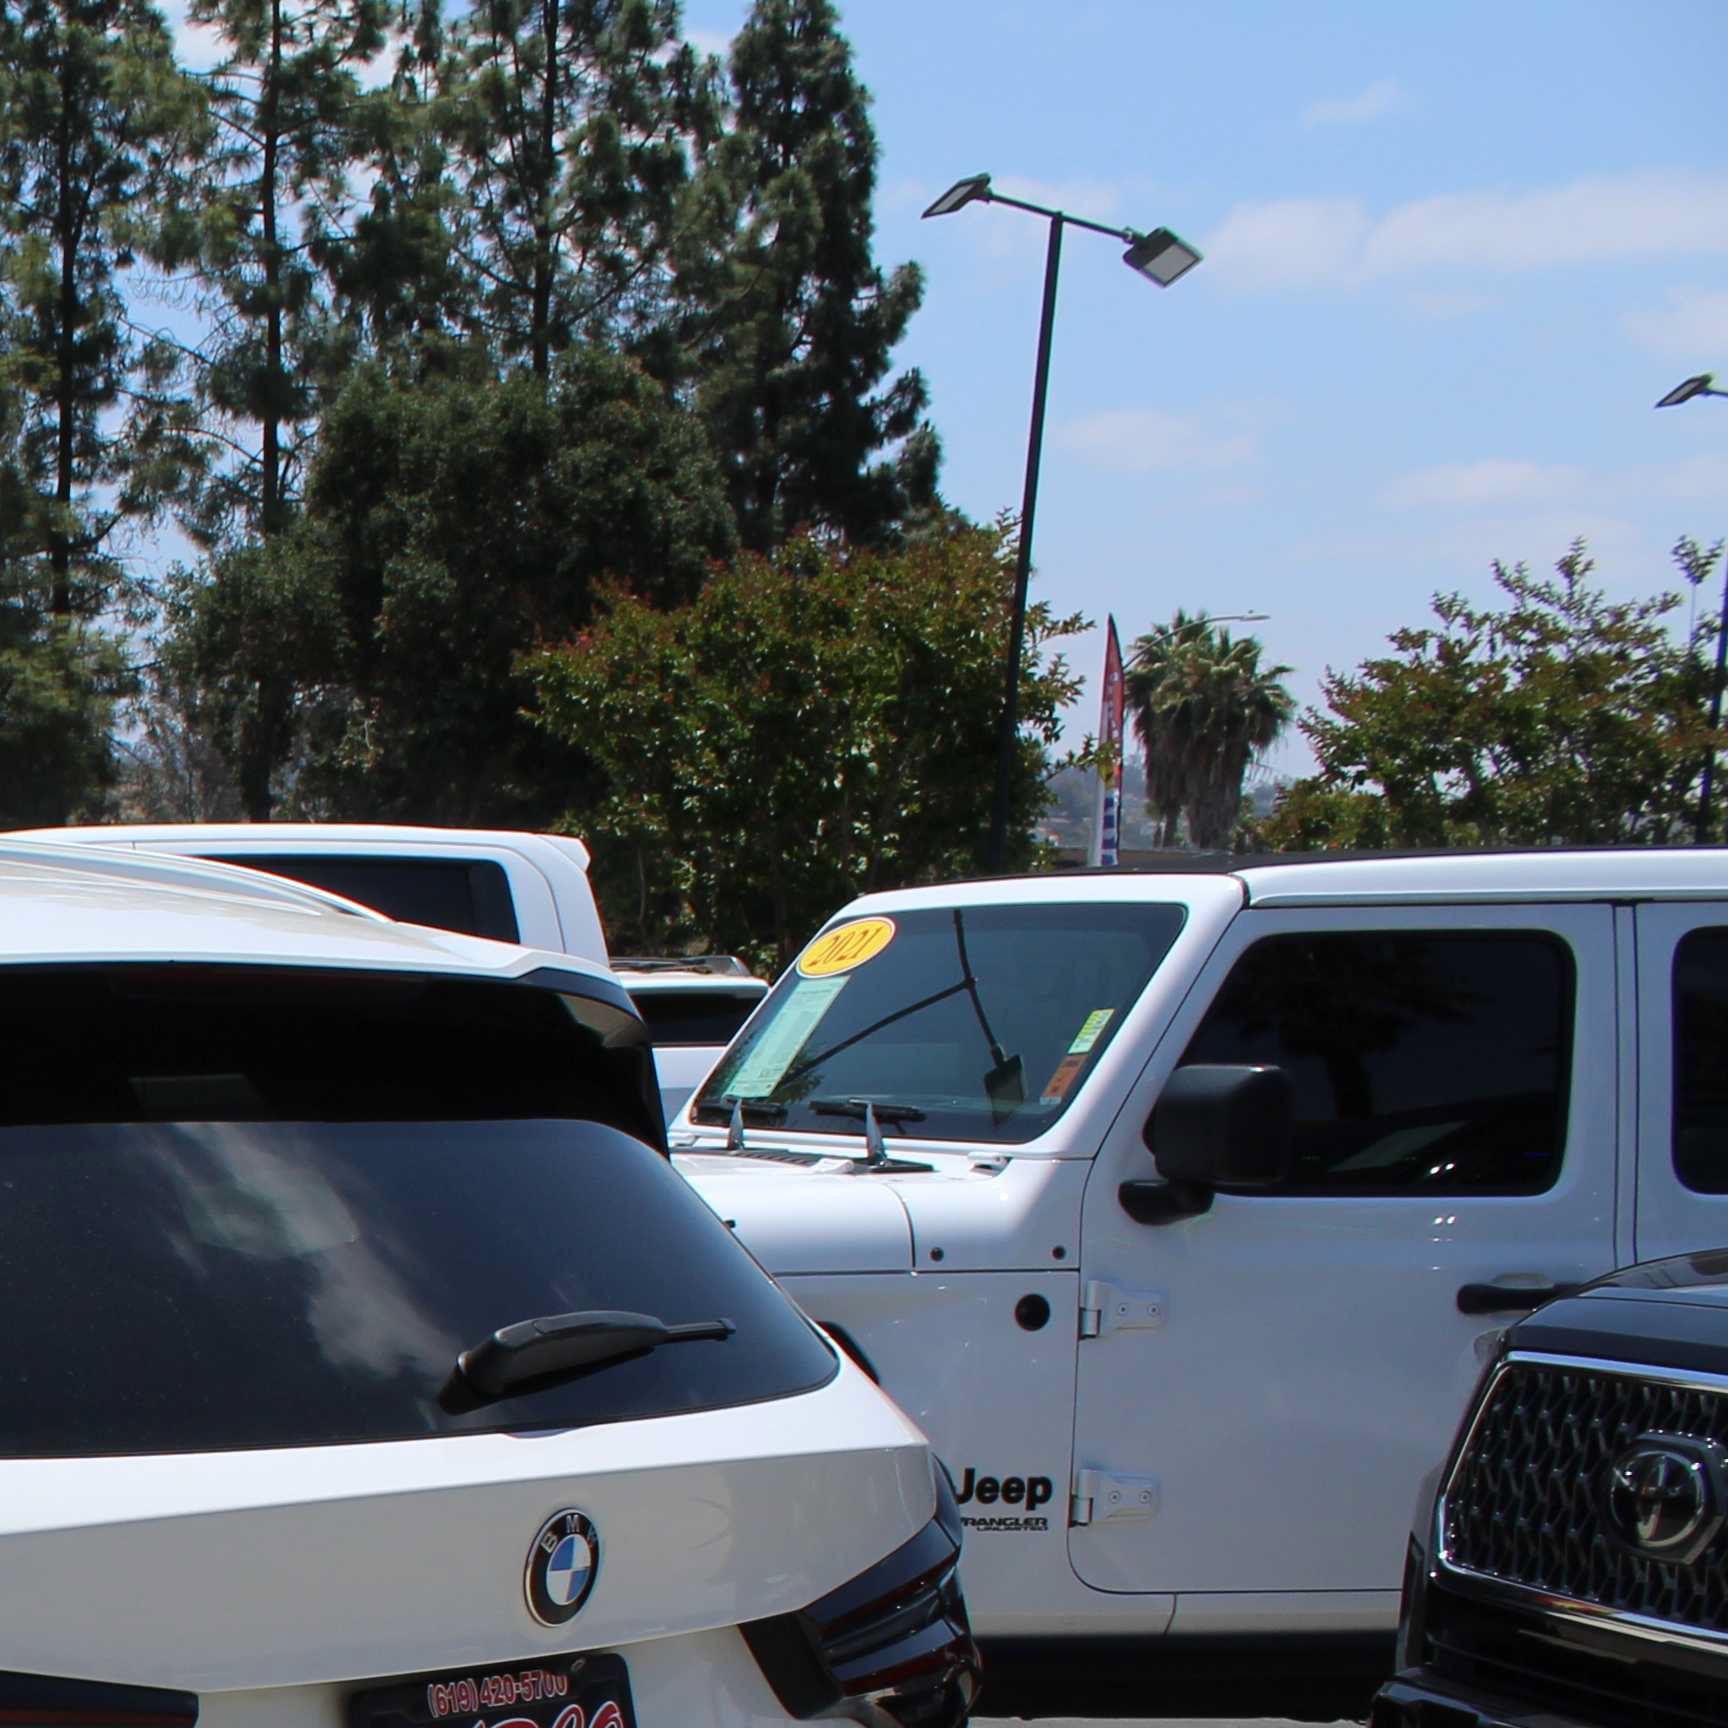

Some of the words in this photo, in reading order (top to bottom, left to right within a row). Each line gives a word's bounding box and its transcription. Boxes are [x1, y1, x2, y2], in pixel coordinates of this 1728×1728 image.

[806, 926, 884, 968] 2021
[955, 1467, 1053, 1511] Jeep
[428, 1678, 478, 1718] (619)
